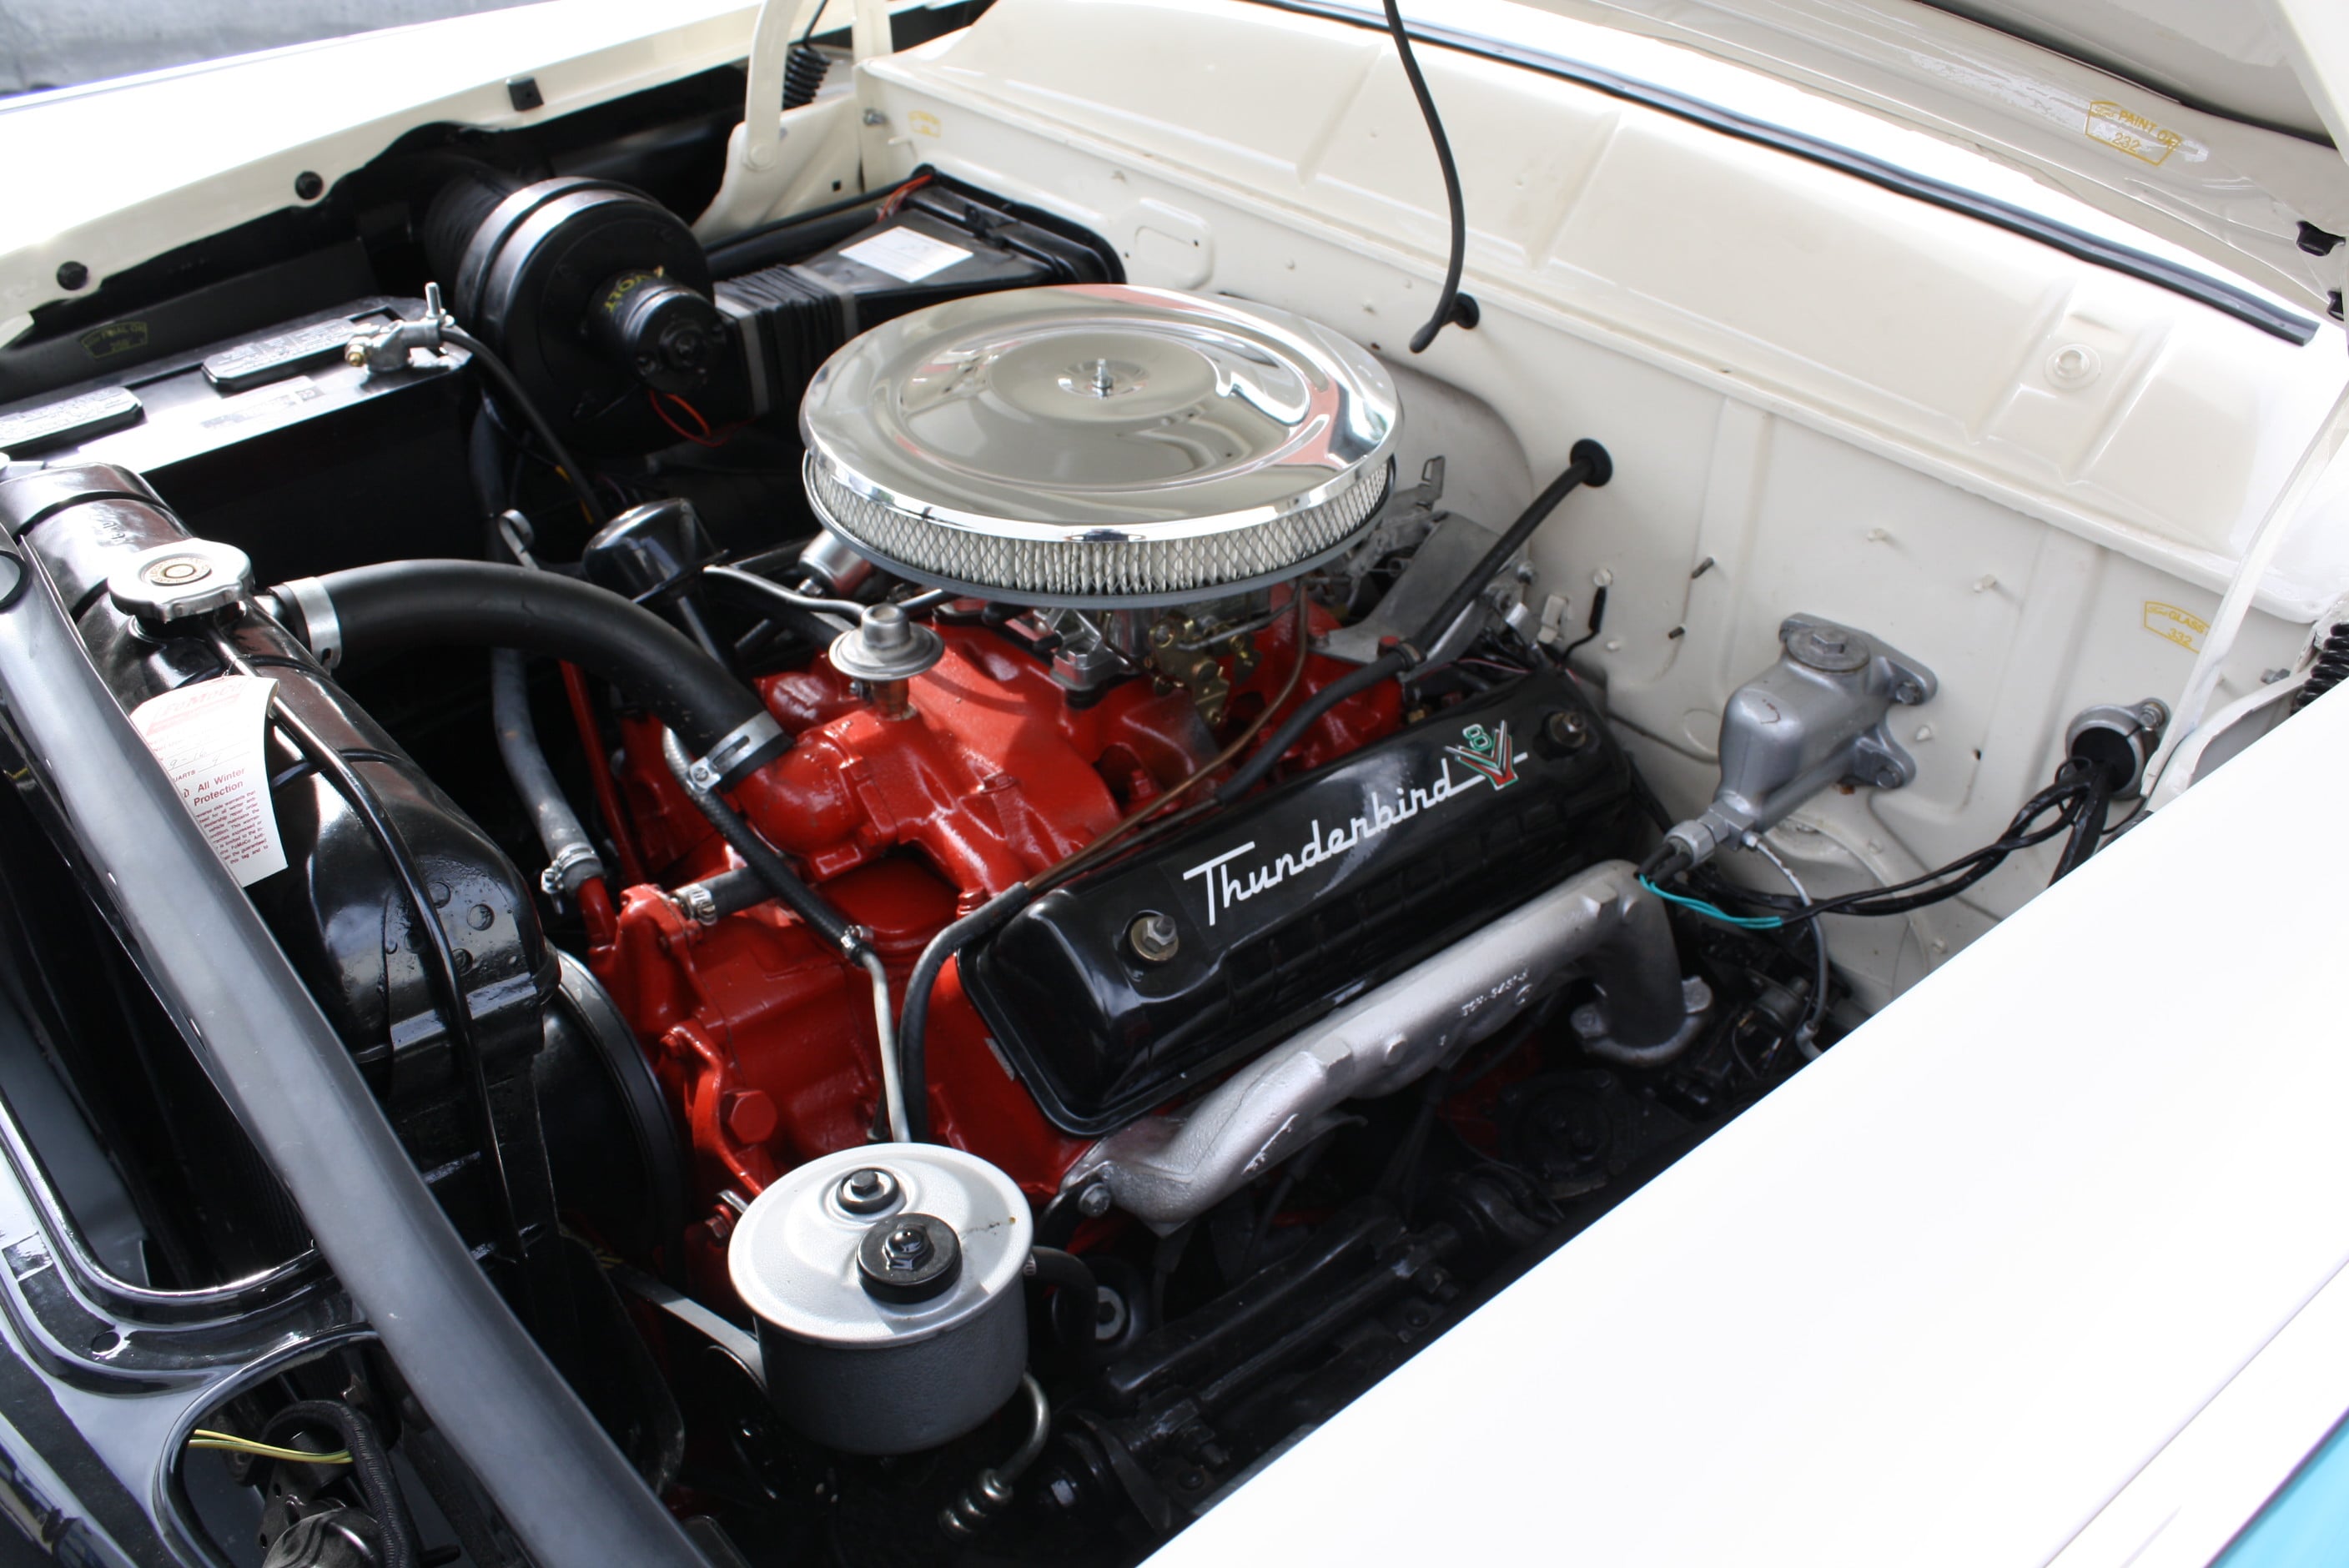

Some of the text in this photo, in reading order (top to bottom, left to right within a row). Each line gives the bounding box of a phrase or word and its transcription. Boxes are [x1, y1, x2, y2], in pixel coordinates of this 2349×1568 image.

[2119, 109, 2159, 133] PAINT
[2112, 133, 2141, 152] 232
[2168, 611, 2205, 633] GLASS
[174, 769, 196, 782] UARTS
[198, 781, 209, 793] All
[214, 768, 245, 786] Winter
[194, 781, 244, 807] Protection
[1183, 756, 1488, 927] Thunderbird
